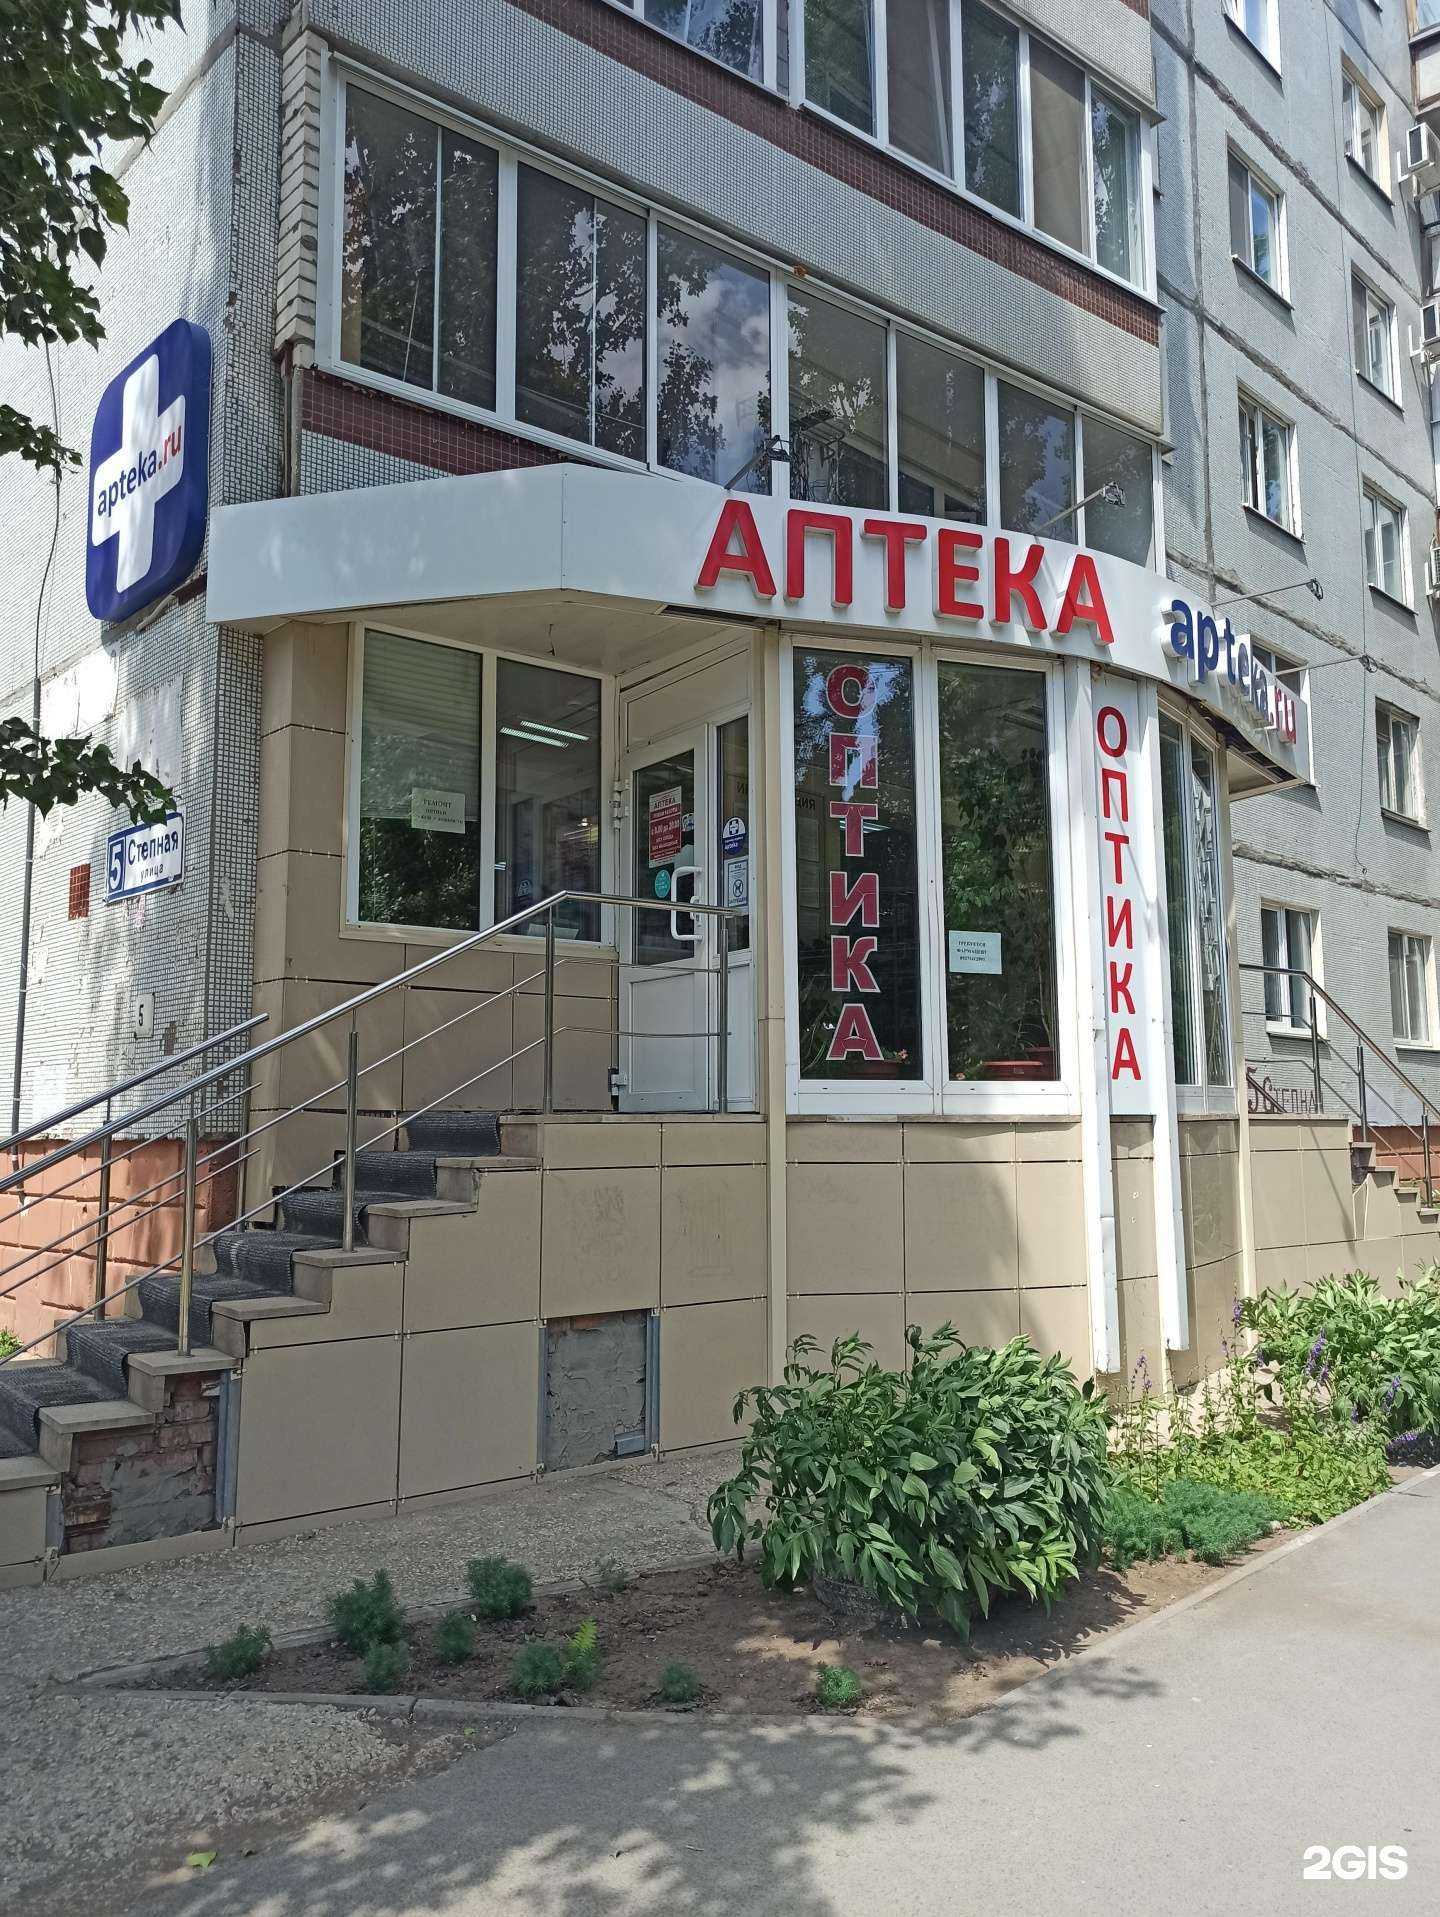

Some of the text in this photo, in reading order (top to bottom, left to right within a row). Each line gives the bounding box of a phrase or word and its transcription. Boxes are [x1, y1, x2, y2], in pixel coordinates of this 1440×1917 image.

[98, 425, 182, 517] apteka.ru
[695, 498, 1116, 645] АПТЕКА
[109, 830, 179, 891] 5 Степная
[140, 863, 164, 883] улица
[825, 664, 885, 1062] ОПТИКА
[1096, 705, 1142, 1081] ОПТИКА
[138, 1004, 145, 1027] 5
